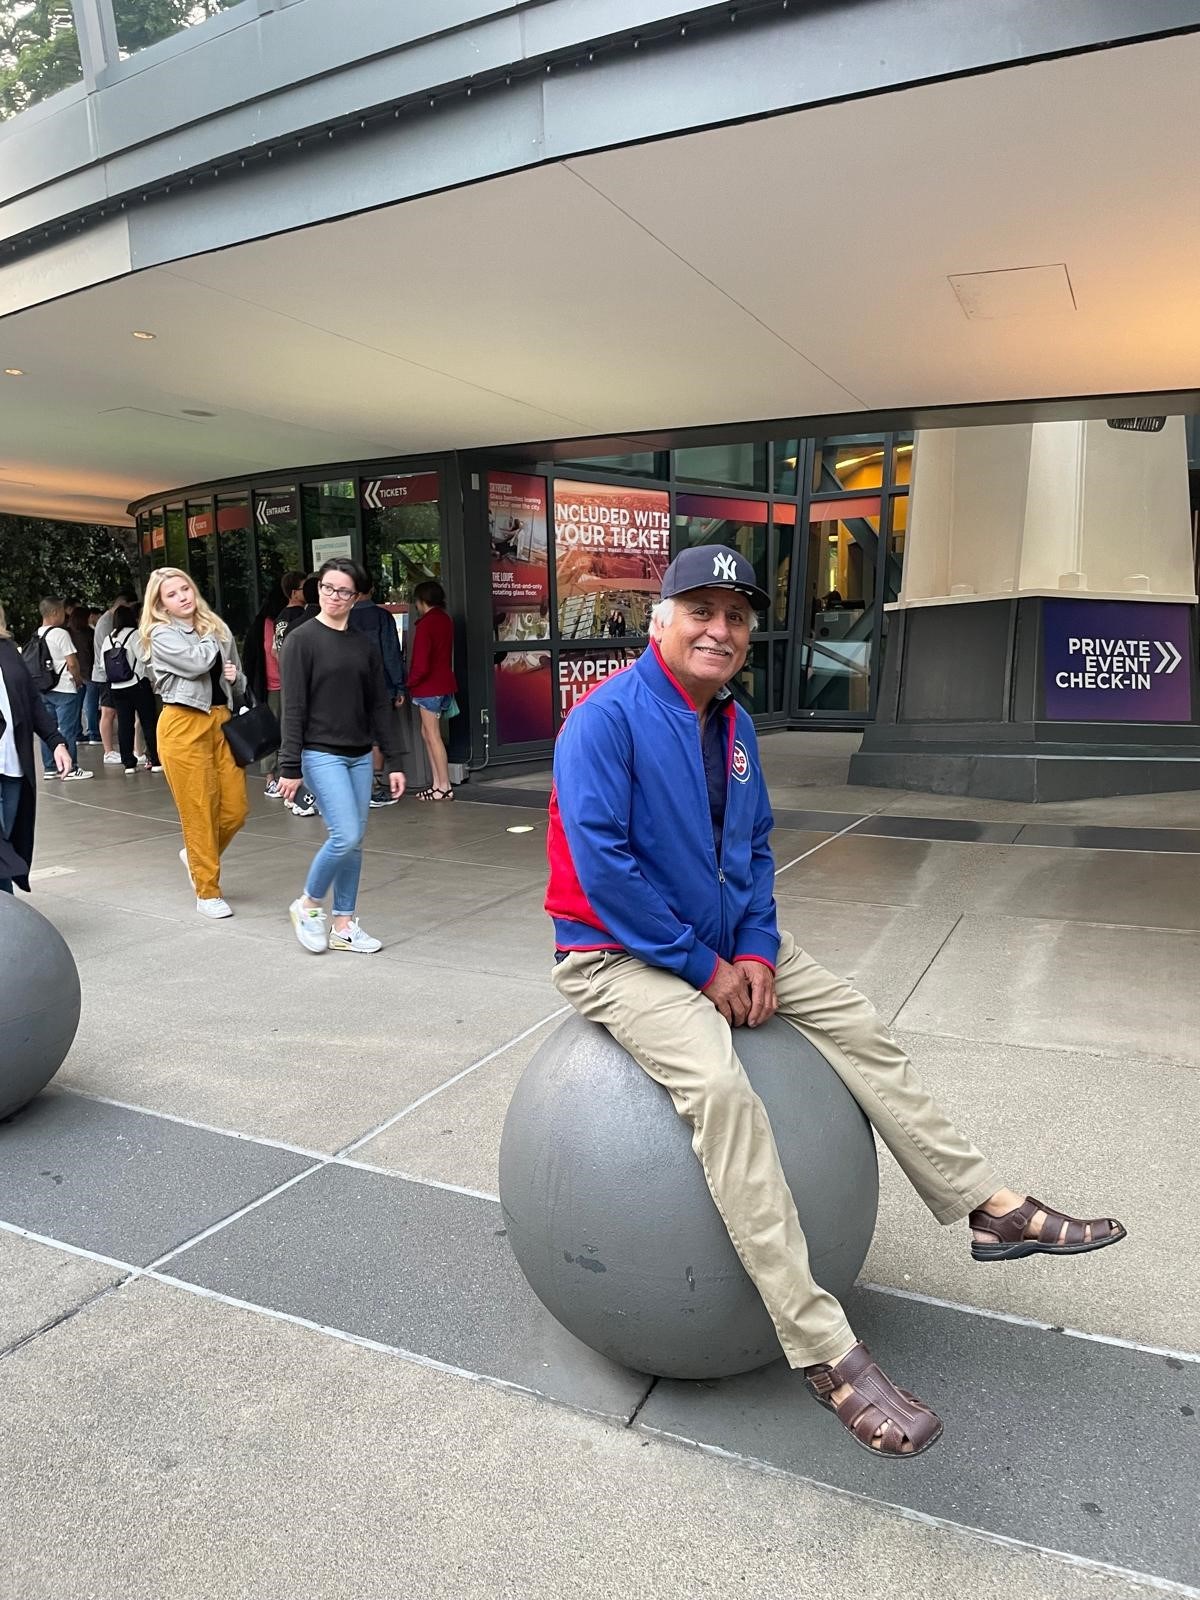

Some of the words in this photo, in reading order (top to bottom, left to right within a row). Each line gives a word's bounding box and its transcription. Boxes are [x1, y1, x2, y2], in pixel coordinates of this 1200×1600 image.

[379, 487, 408, 498] TICKETS
[266, 505, 290, 516] ENTRANCE
[554, 503, 630, 525] INCLUDED
[633, 510, 670, 529] WITH
[554, 523, 605, 546] YOUR
[608, 526, 670, 549] TICKET
[492, 571, 500, 582] THE
[501, 572, 514, 582] LOUPE
[1068, 638, 1150, 656] PRIVATE
[1085, 656, 1151, 672] EVENT
[1055, 672, 1151, 690] CHECK-IN
